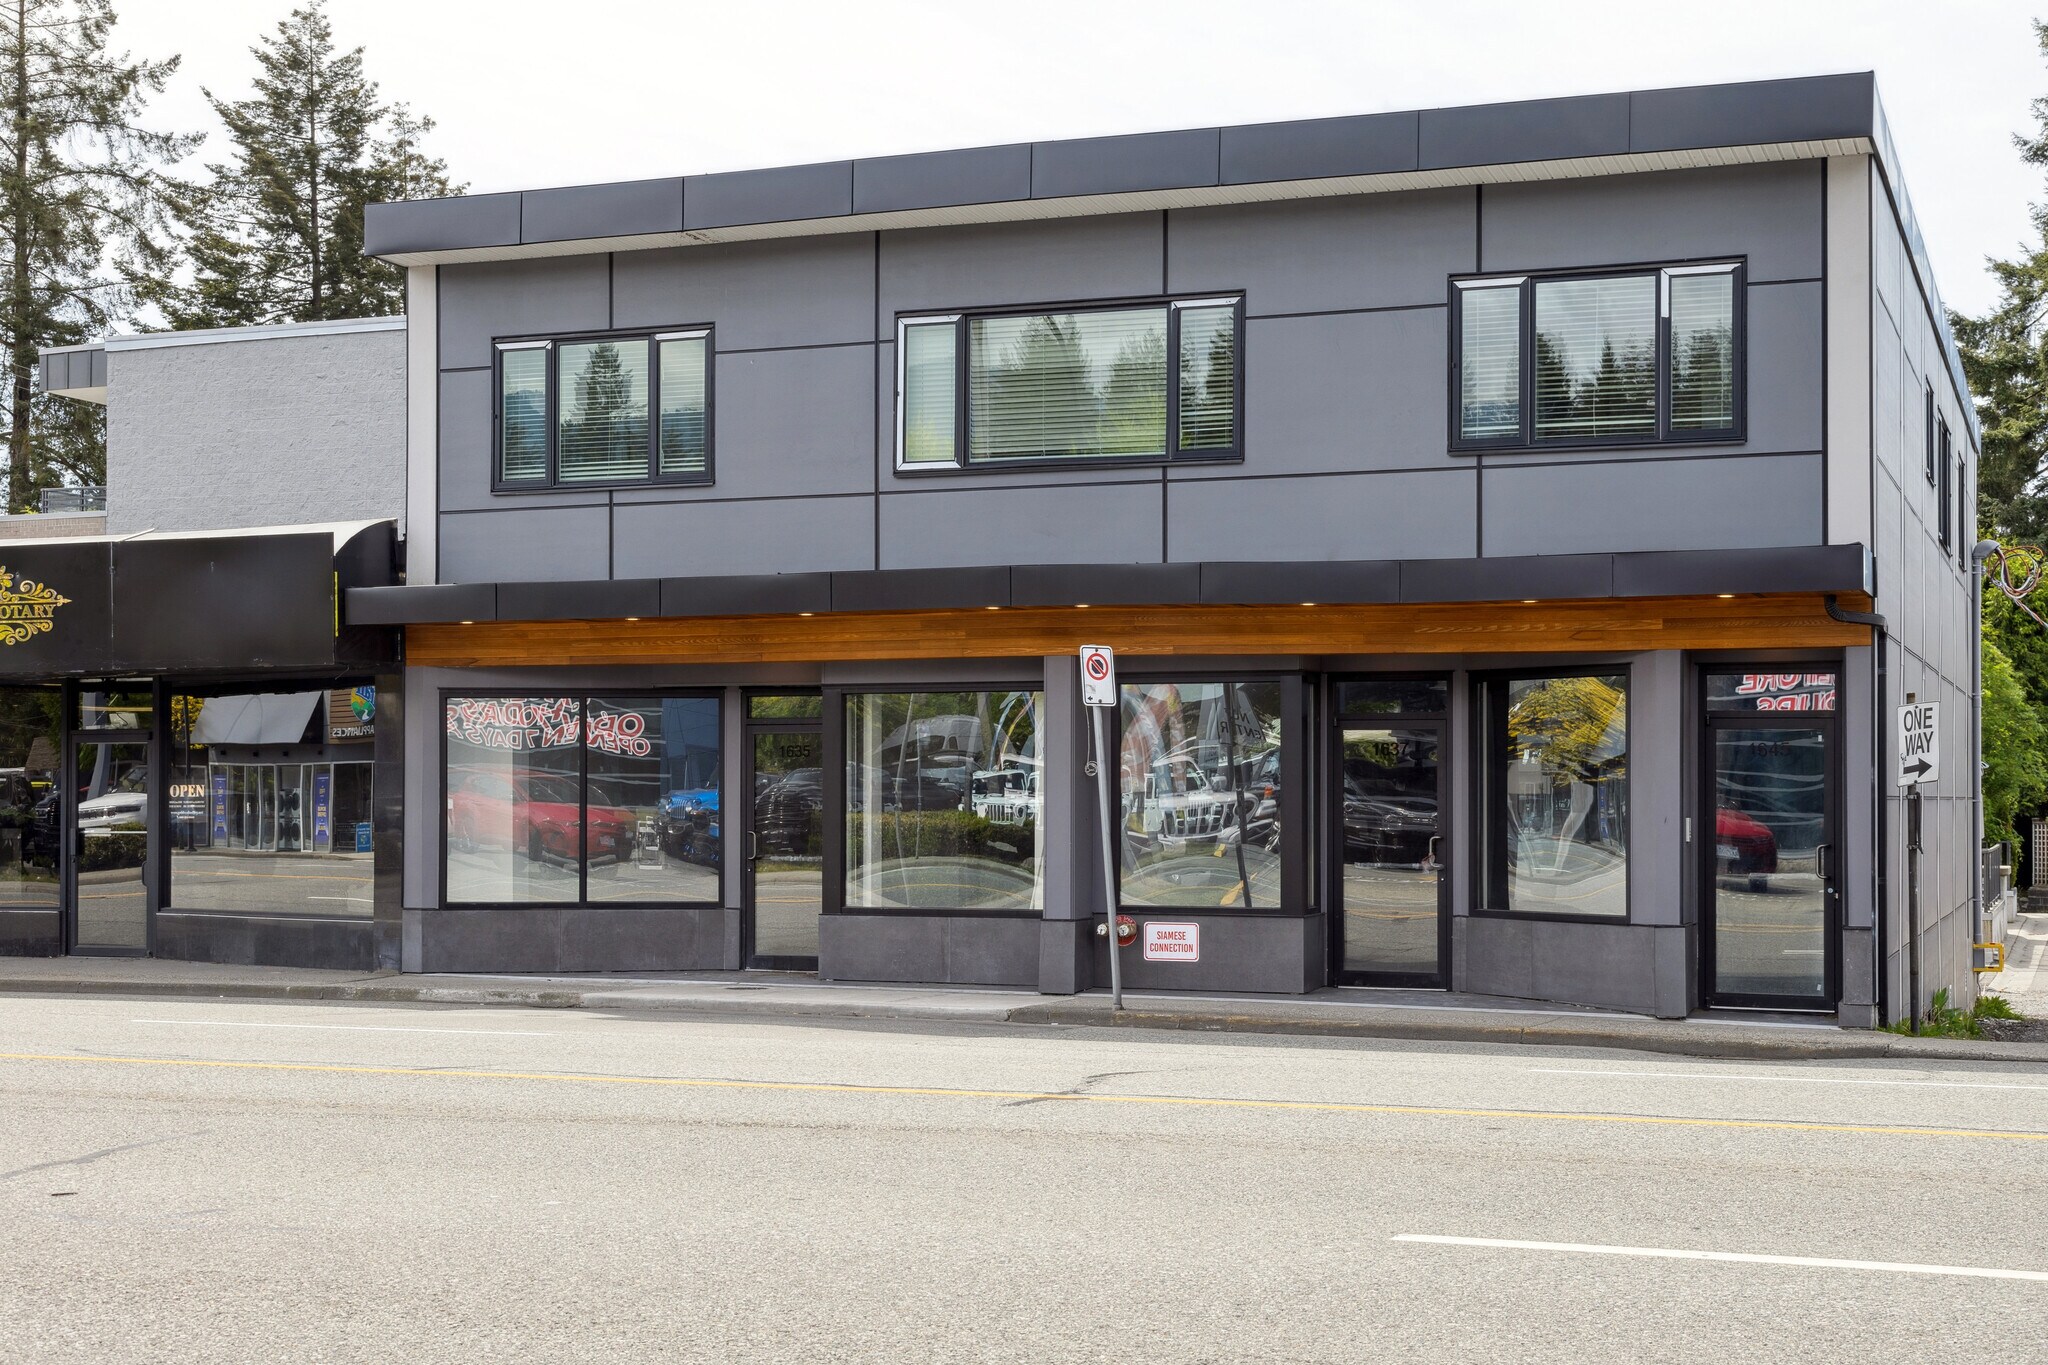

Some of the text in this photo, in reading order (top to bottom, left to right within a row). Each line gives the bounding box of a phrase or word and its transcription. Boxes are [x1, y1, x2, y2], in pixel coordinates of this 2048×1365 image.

[1903, 707, 1933, 732] ONE
[1372, 742, 1408, 756] 1637
[1904, 731, 1934, 756] WAY
[779, 744, 810, 758] 1635
[169, 784, 206, 798] OPEN
[1156, 930, 1187, 941] SIAMESE
[1149, 942, 1194, 953] CONNECTION
